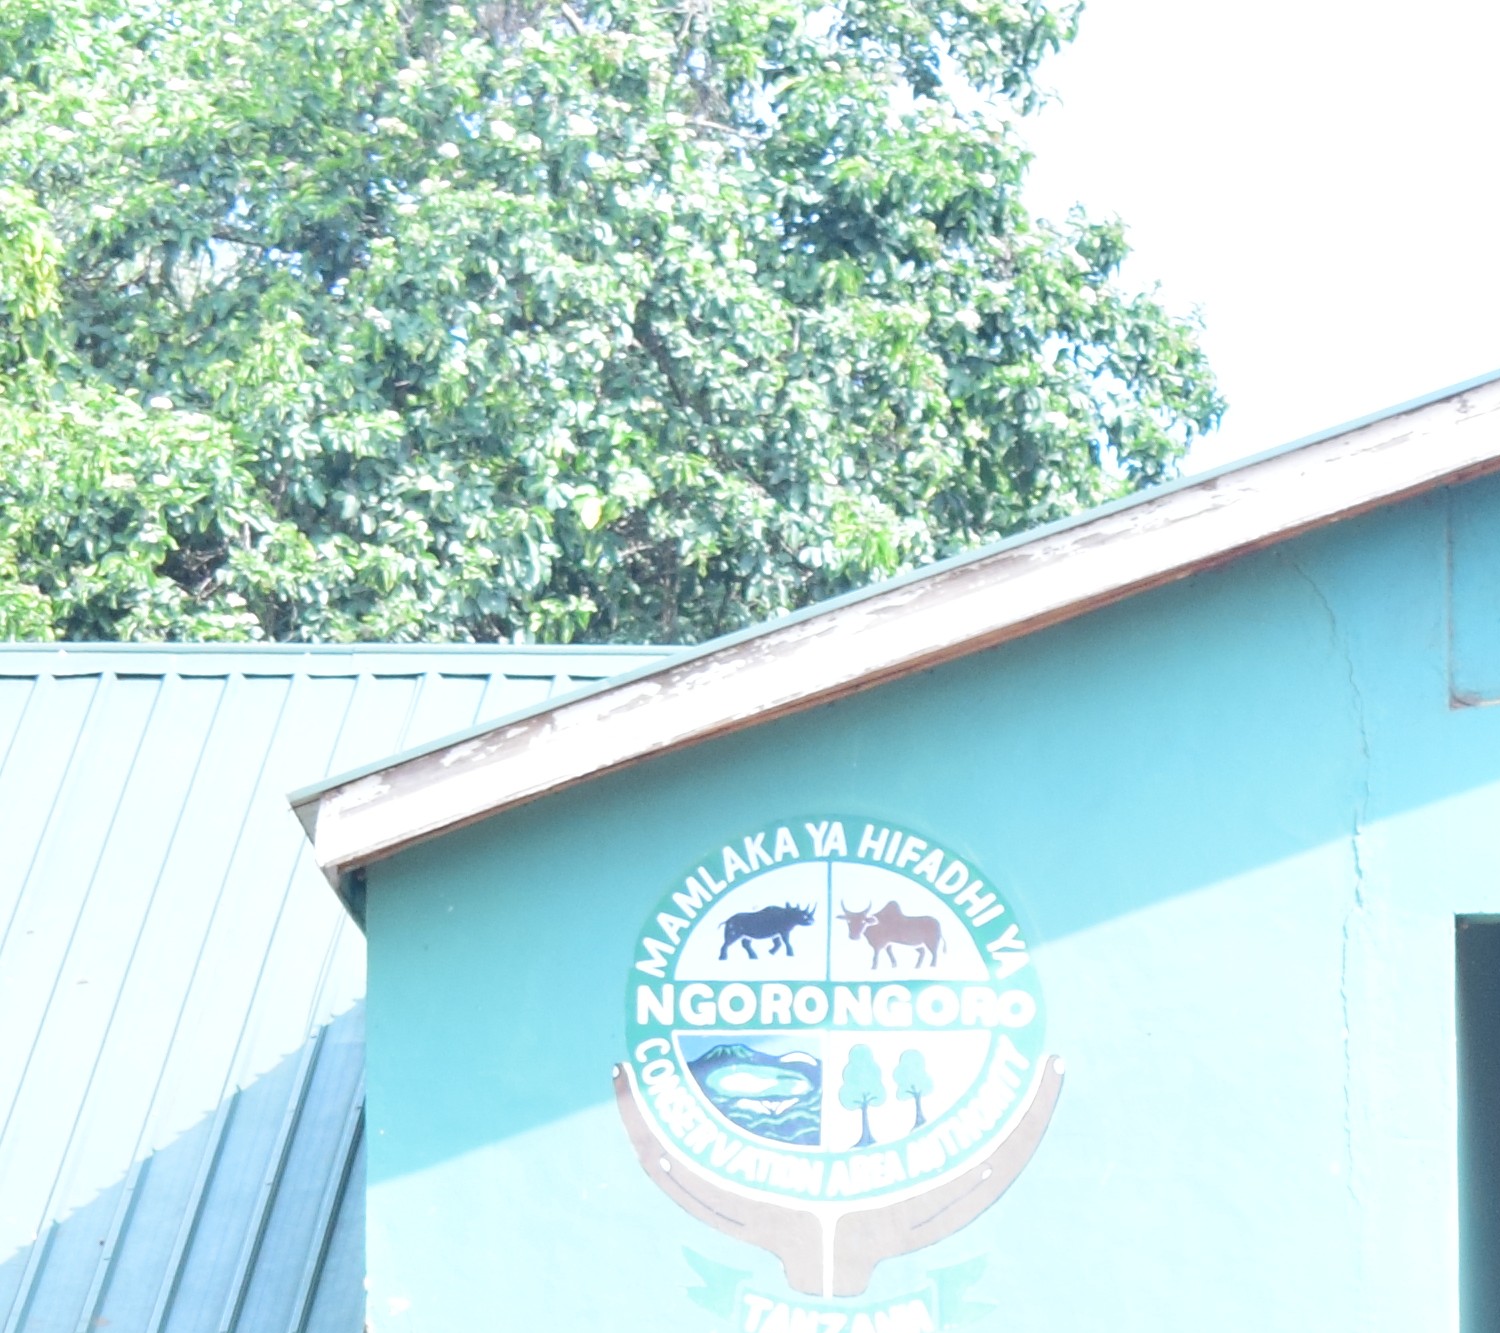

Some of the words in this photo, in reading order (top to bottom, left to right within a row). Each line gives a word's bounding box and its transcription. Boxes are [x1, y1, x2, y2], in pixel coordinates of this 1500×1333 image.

[635, 827, 799, 977] MAMLAKA
[805, 821, 847, 857] YA
[857, 824, 1006, 927] HIFADHI
[985, 924, 1030, 980] YA
[636, 983, 1036, 1028] NGORONGORO
[634, 1037, 823, 1196] CONSERVATION
